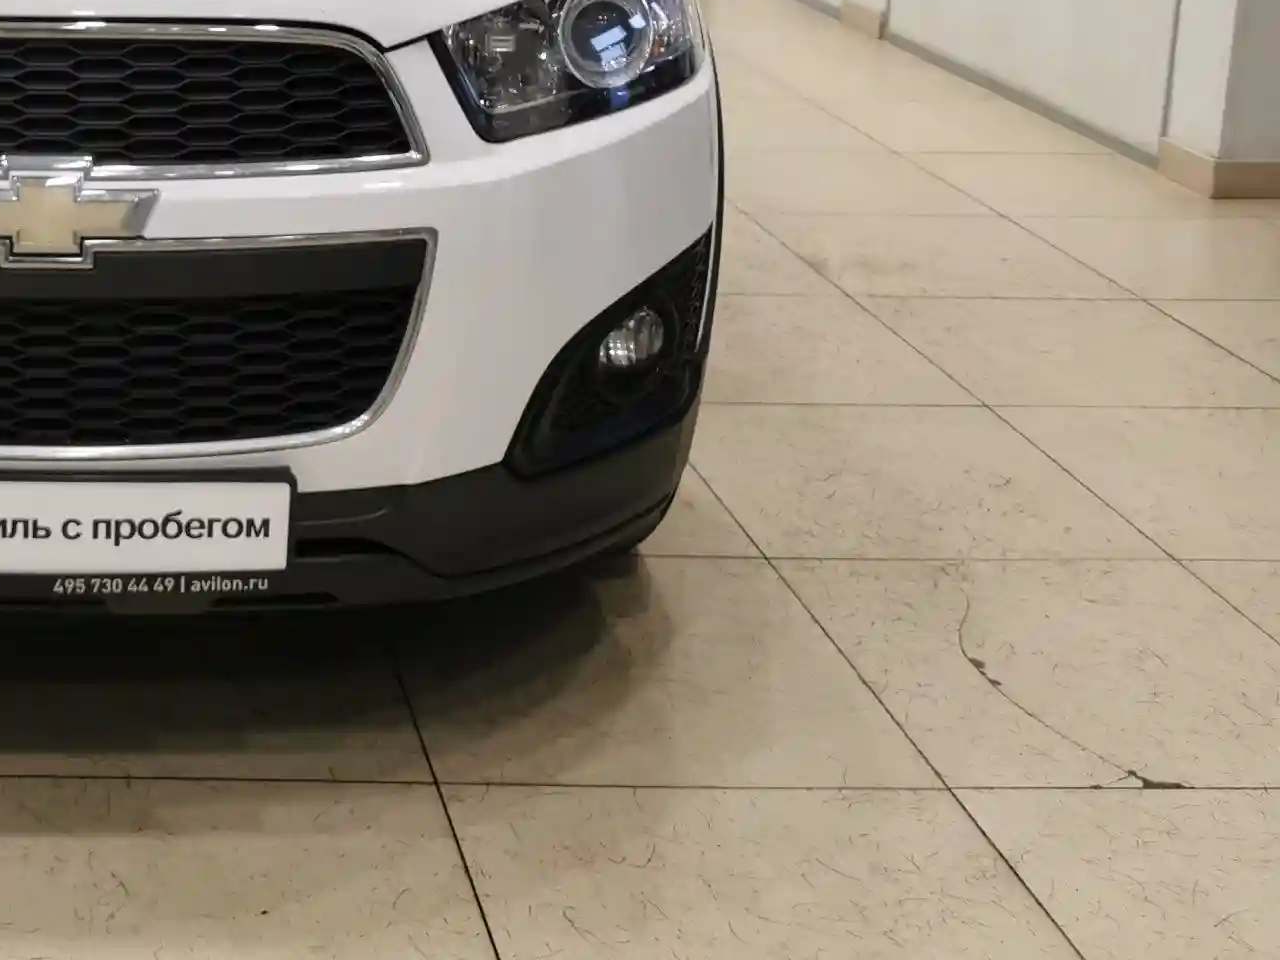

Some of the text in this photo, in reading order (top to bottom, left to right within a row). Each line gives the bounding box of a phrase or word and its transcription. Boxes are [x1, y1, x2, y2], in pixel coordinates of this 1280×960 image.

[61, 518, 82, 540] с
[92, 510, 271, 547] пробегом
[52, 578, 86, 594] 495
[91, 577, 122, 594] 730
[126, 577, 149, 593] 44
[152, 577, 175, 593] 49
[190, 574, 269, 593] avilon.ru
